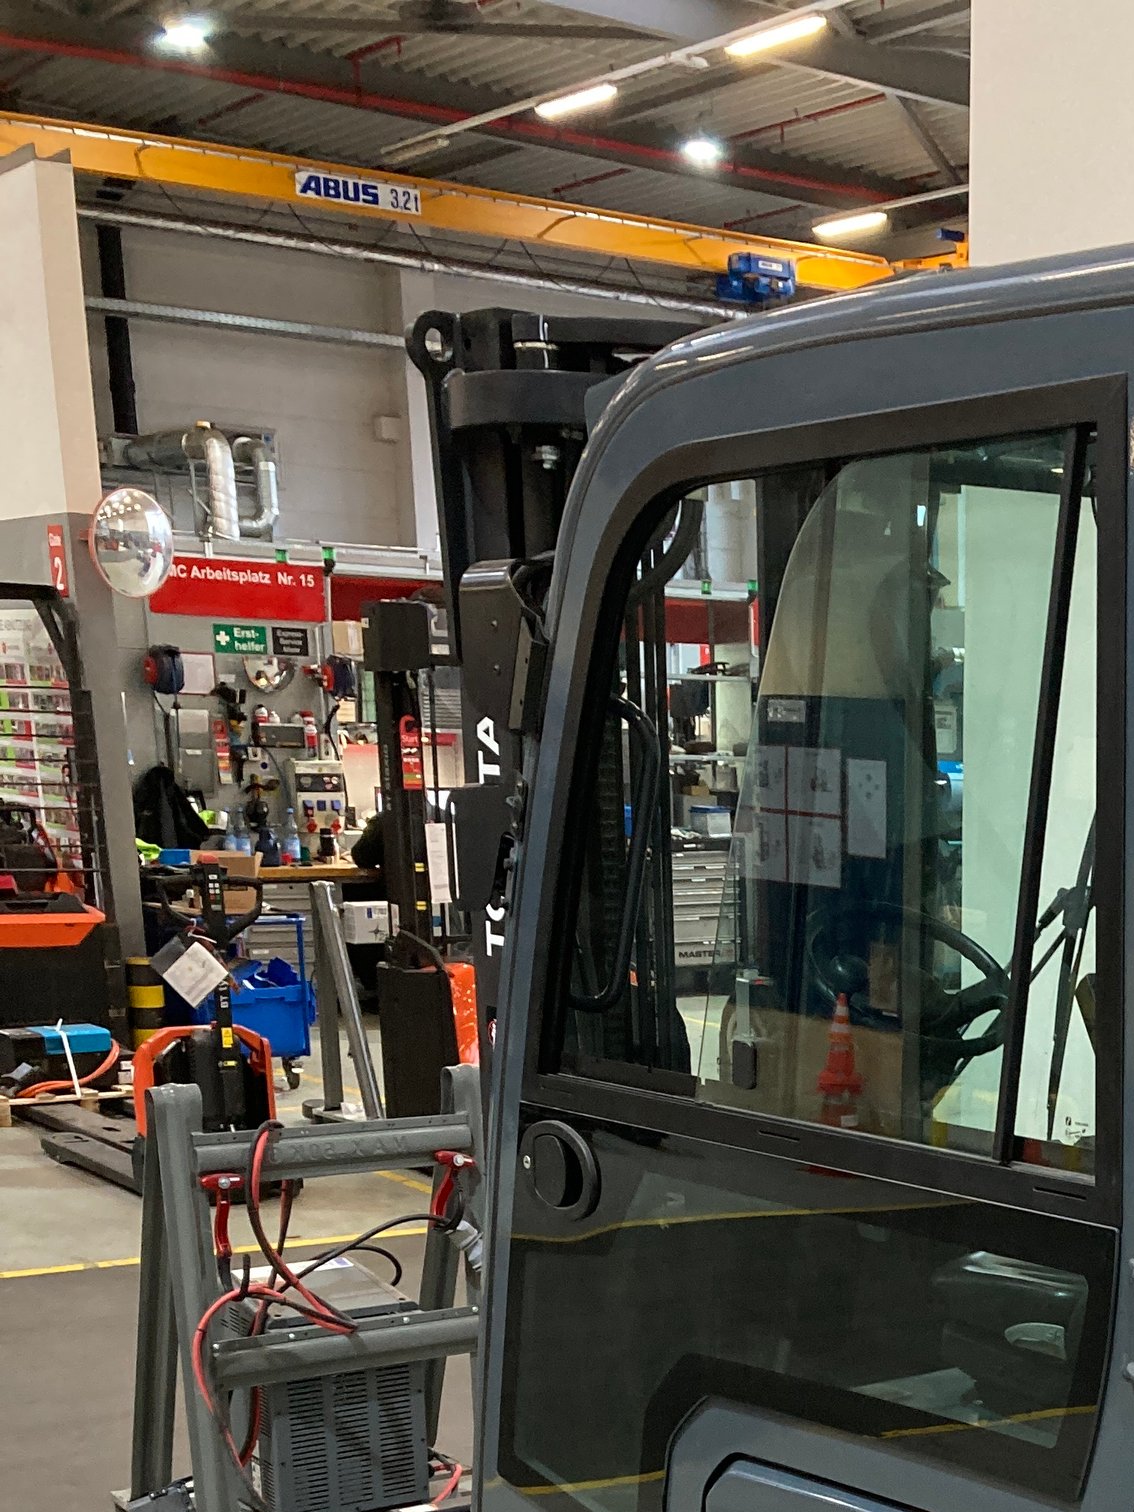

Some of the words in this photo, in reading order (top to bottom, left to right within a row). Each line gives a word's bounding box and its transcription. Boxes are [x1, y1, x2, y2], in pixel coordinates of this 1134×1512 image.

[300, 174, 379, 206] ABUS
[53, 556, 65, 591] 2
[190, 565, 272, 585] Arbeitsplatz
[277, 571, 296, 586] Nr.
[299, 573, 315, 588] 15
